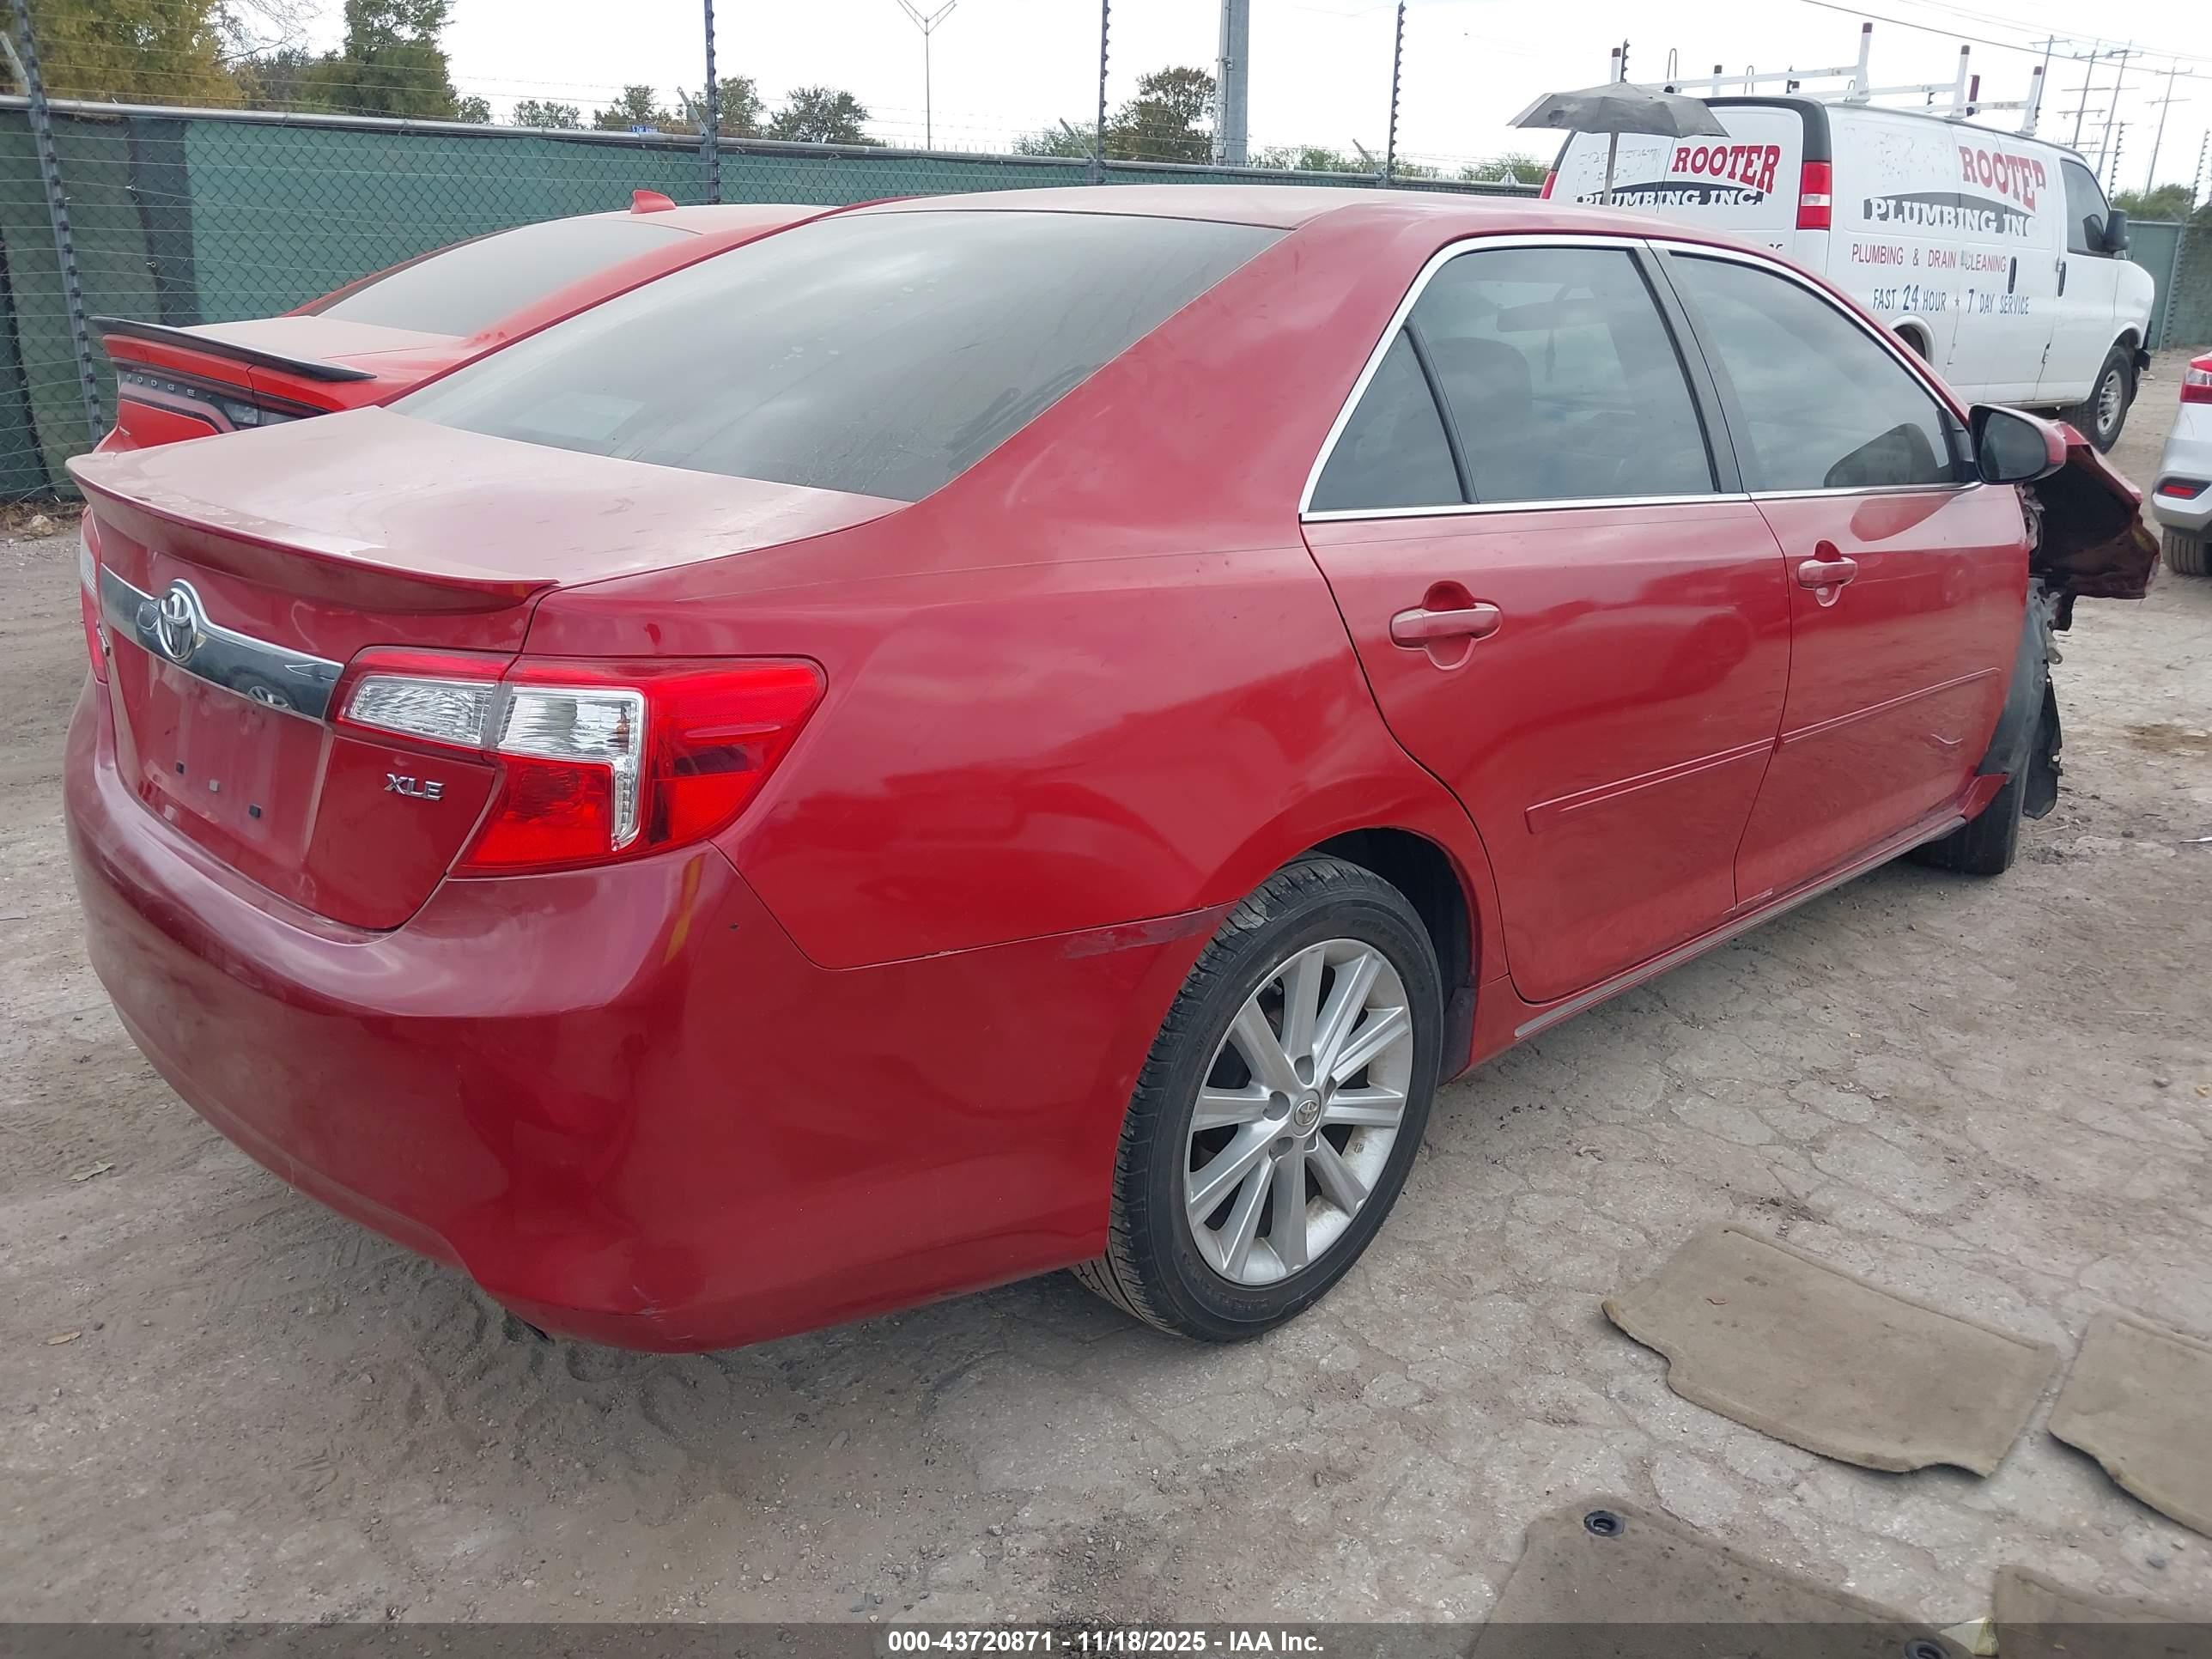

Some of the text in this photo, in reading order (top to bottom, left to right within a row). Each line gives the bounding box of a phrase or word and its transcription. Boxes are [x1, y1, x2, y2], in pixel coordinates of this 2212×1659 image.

[1672, 144, 1781, 194] ROOTER
[1869, 198, 1999, 234] PLUMBING
[1850, 243, 1904, 266] PLUMBING
[1912, 247, 1920, 267] &
[1928, 249, 1957, 269] DRAIN
[1873, 284, 2030, 316] FAST 24 HOUR 7 DAY SERVICE
[125, 374, 196, 398] DODGE
[384, 773, 446, 801] XLE
